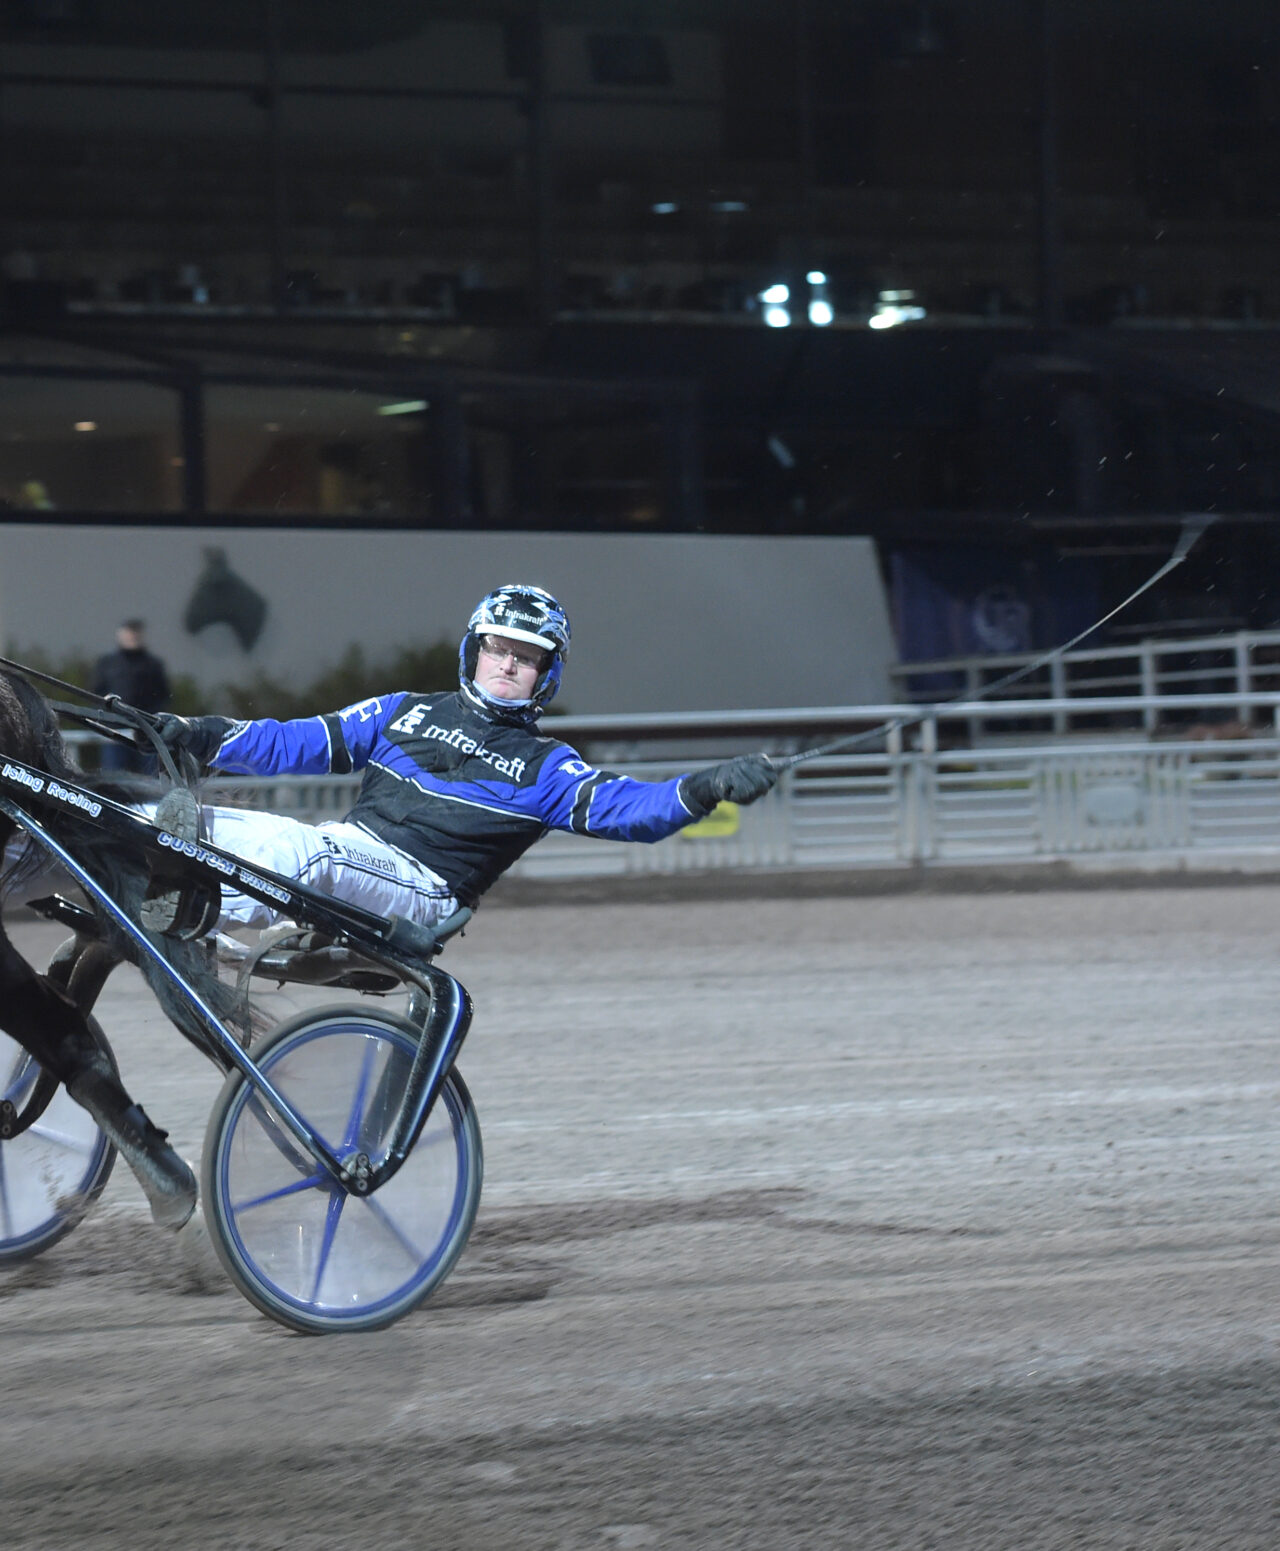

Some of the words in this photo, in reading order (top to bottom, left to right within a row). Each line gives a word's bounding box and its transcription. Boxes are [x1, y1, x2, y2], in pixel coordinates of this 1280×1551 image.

[1, 763, 44, 792] Ising
[46, 781, 102, 817] Racing
[157, 831, 236, 876] CUSTOM
